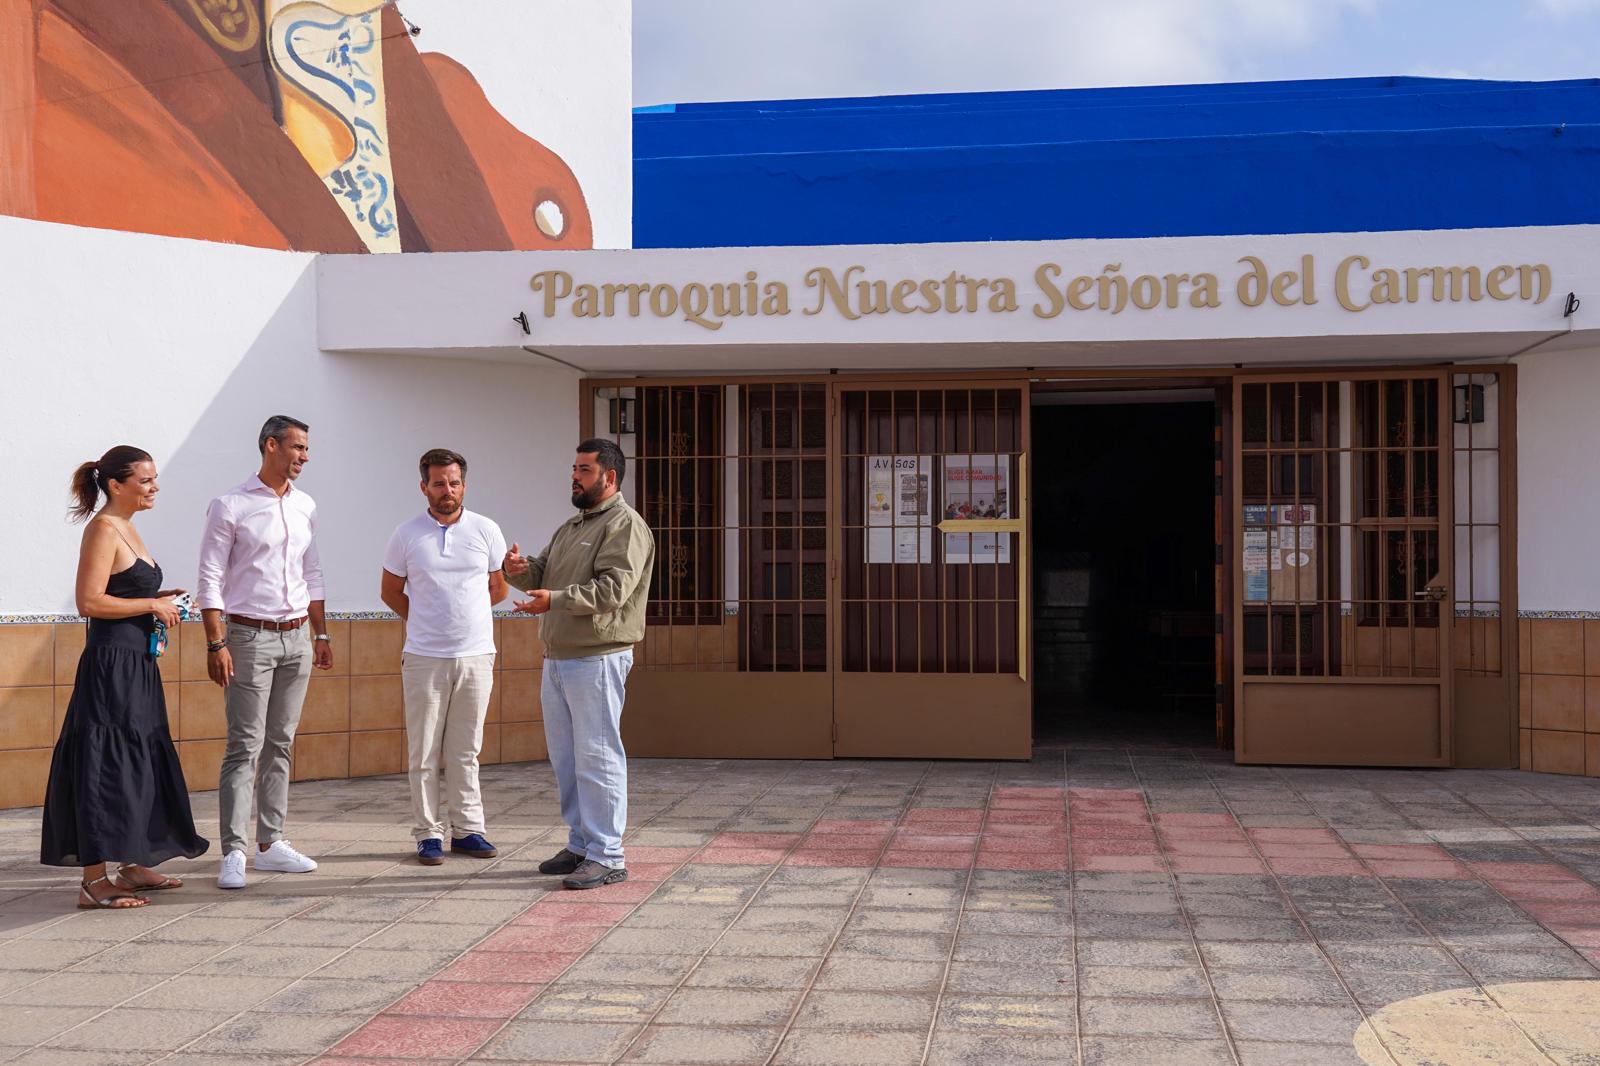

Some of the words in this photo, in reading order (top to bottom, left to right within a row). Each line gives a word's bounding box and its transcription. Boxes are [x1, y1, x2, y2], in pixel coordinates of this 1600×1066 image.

[803, 264, 1019, 320] Nuestra
[1033, 262, 1221, 320] Señora
[1237, 253, 1318, 308] del
[1334, 255, 1553, 313] Carmen
